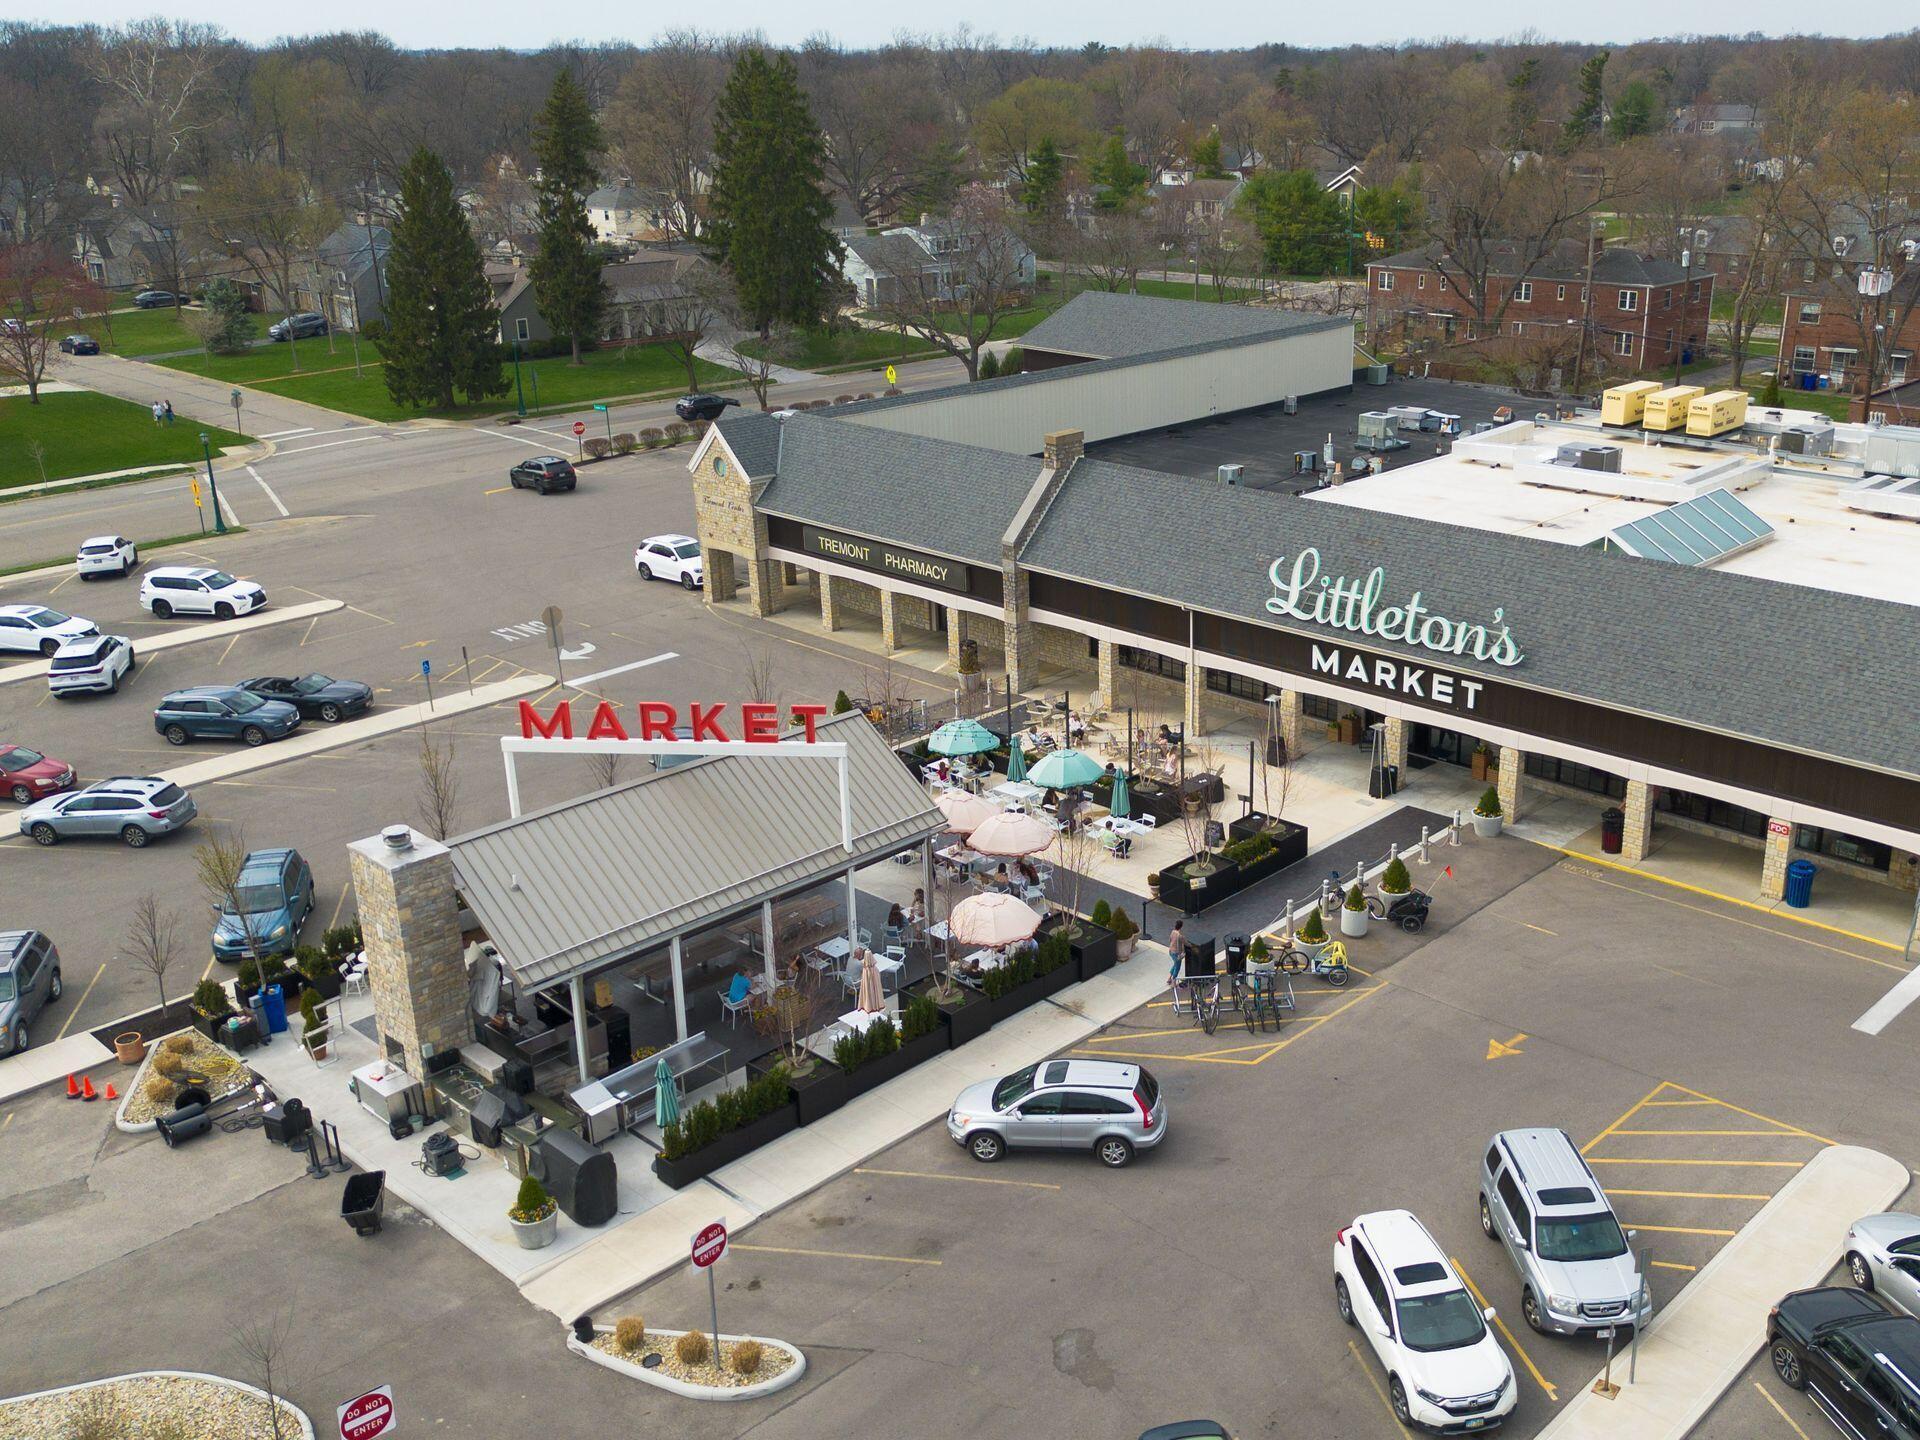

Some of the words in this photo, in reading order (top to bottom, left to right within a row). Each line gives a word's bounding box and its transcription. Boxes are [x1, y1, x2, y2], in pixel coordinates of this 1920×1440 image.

[818, 536, 870, 561] TREMONT
[885, 553, 948, 581] PHARMACY
[1265, 547, 1525, 666] Littleton's
[1311, 644, 1483, 709] MARKET
[518, 699, 827, 744] MARKET
[1770, 823, 1788, 834] FDC
[696, 1237, 706, 1247] DO
[708, 1227, 721, 1240] NOT
[700, 1246, 720, 1262] ENTER
[347, 1408, 360, 1420] DO
[365, 1397, 383, 1411] NOT
[353, 1418, 383, 1437] ENTER
